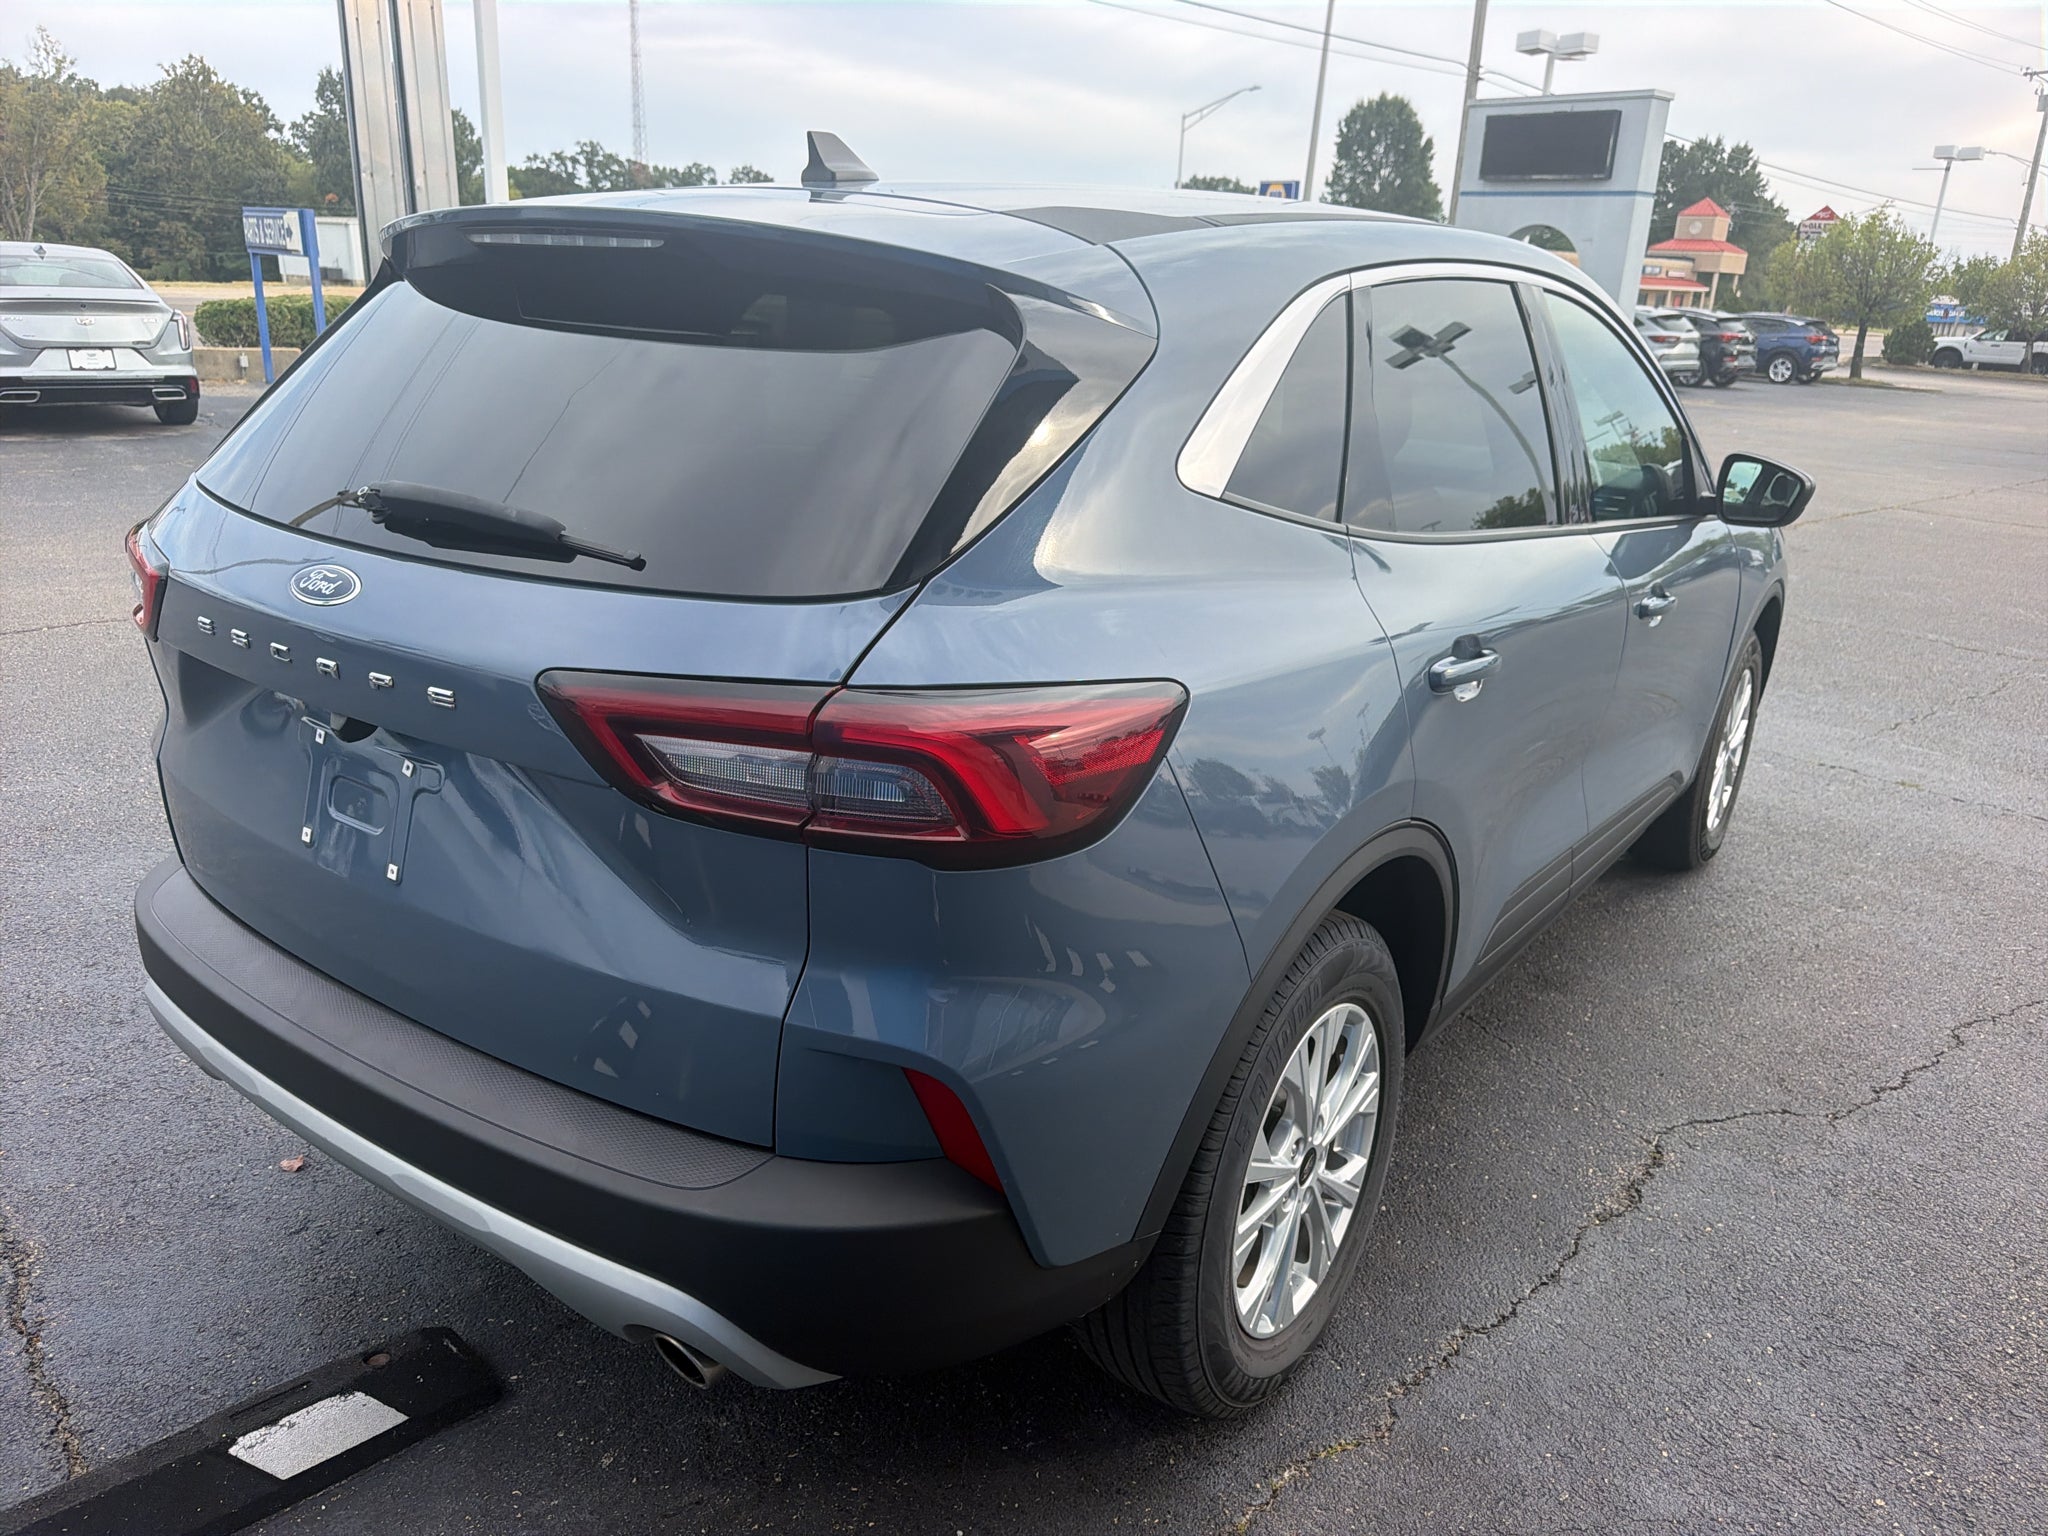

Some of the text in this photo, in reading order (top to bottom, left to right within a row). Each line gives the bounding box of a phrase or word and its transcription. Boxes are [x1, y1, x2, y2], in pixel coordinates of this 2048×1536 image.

[264, 218, 286, 245] SERVICE
[299, 569, 343, 595] Ford
[197, 615, 456, 708] ESCAPE
